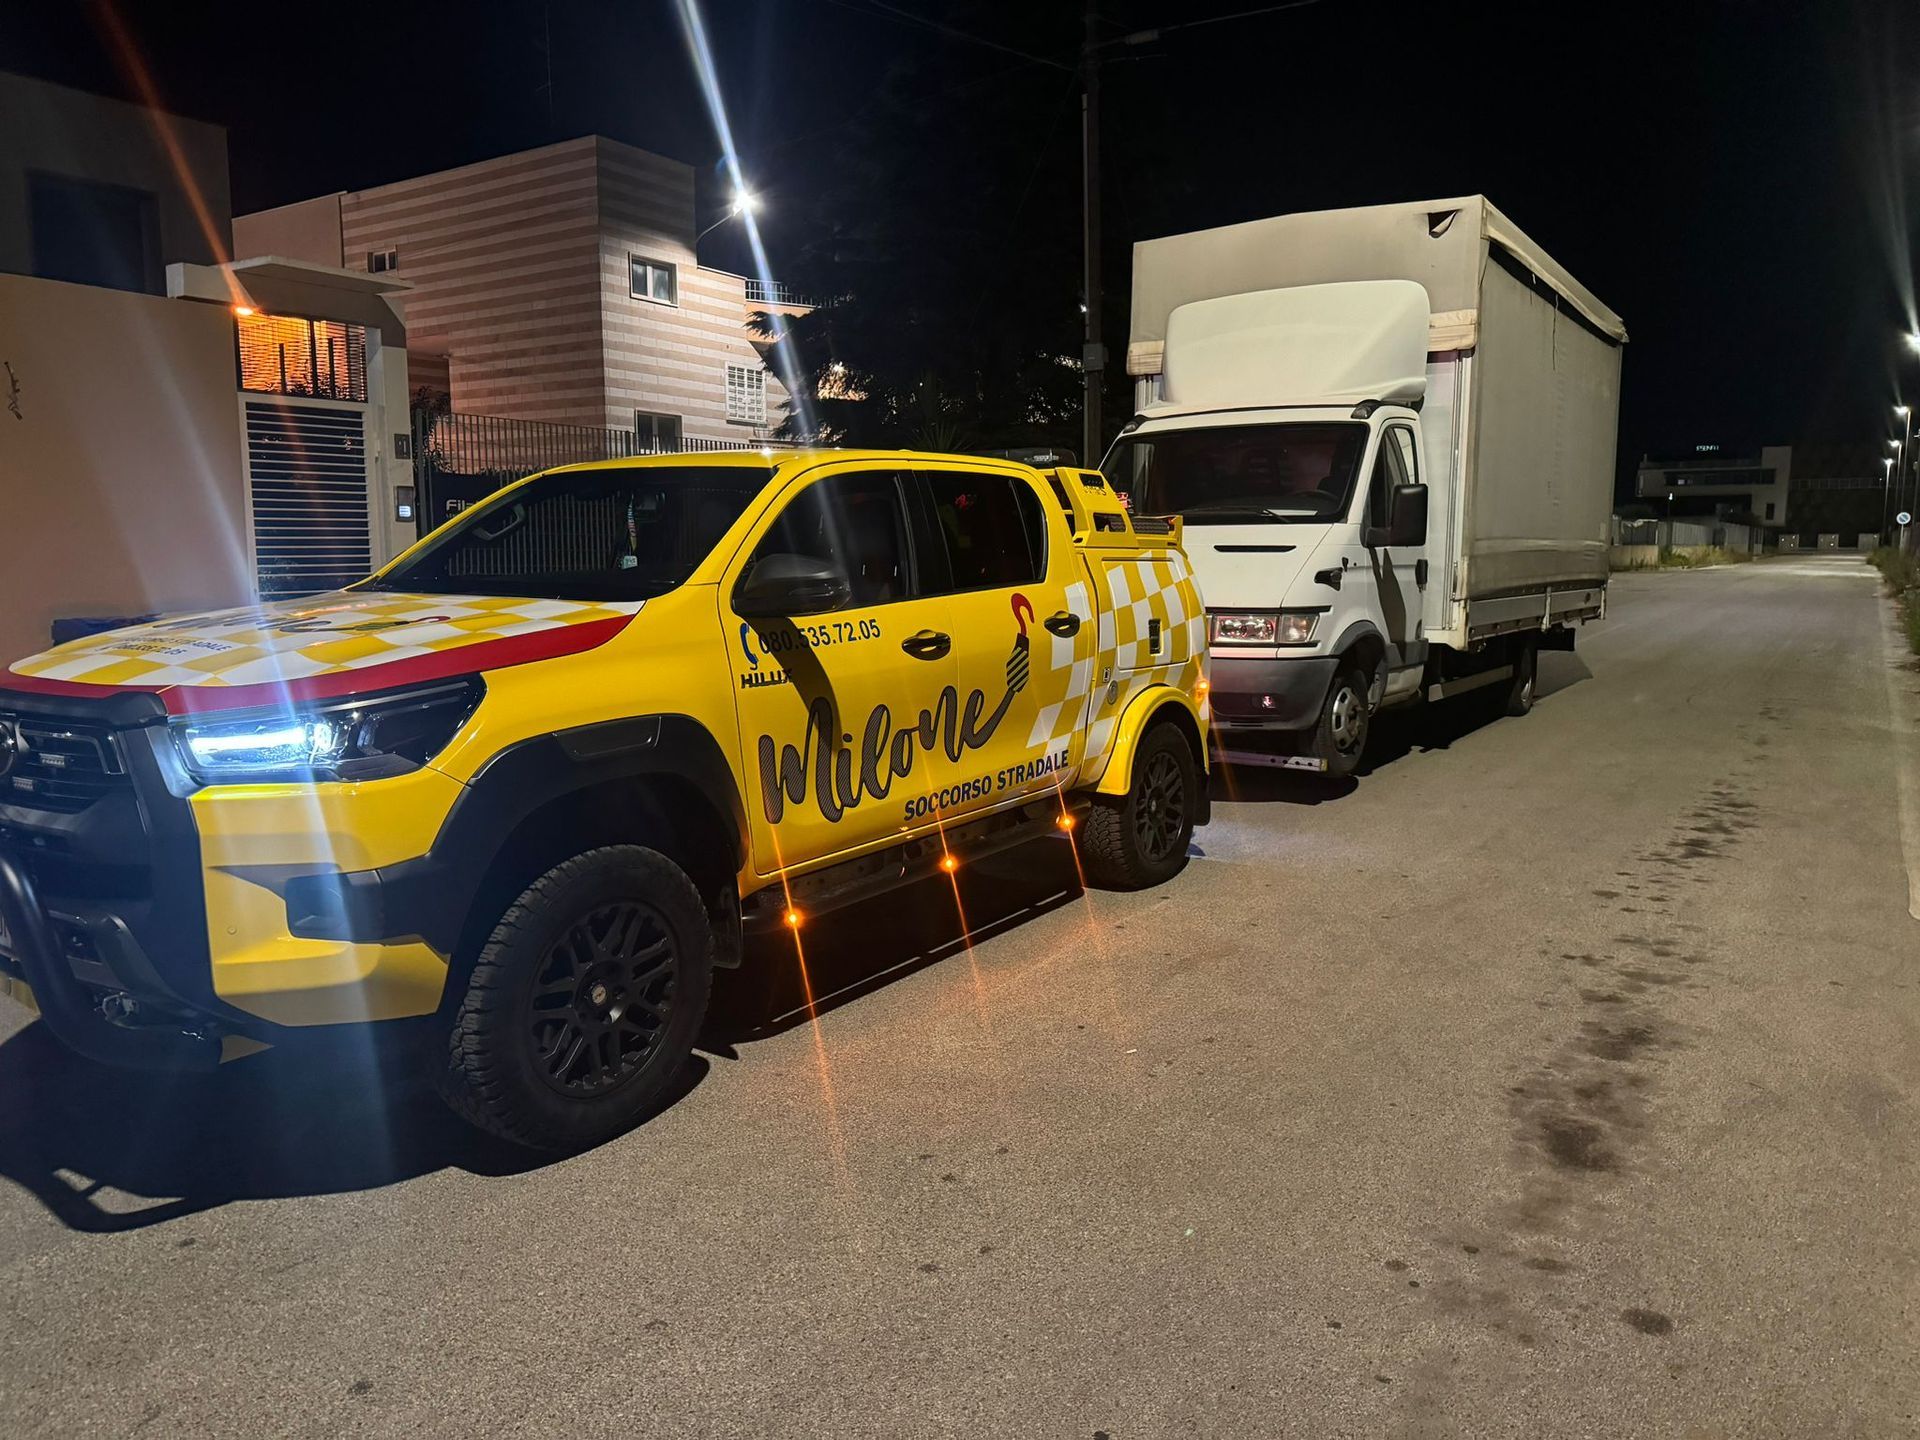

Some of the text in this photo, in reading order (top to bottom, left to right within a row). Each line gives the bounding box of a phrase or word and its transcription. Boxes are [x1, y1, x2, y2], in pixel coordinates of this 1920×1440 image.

[759, 619, 881, 654] 080.535.72.05
[740, 668, 793, 689] HILUX
[904, 749, 1069, 821] SOCCORSO STRADALE
